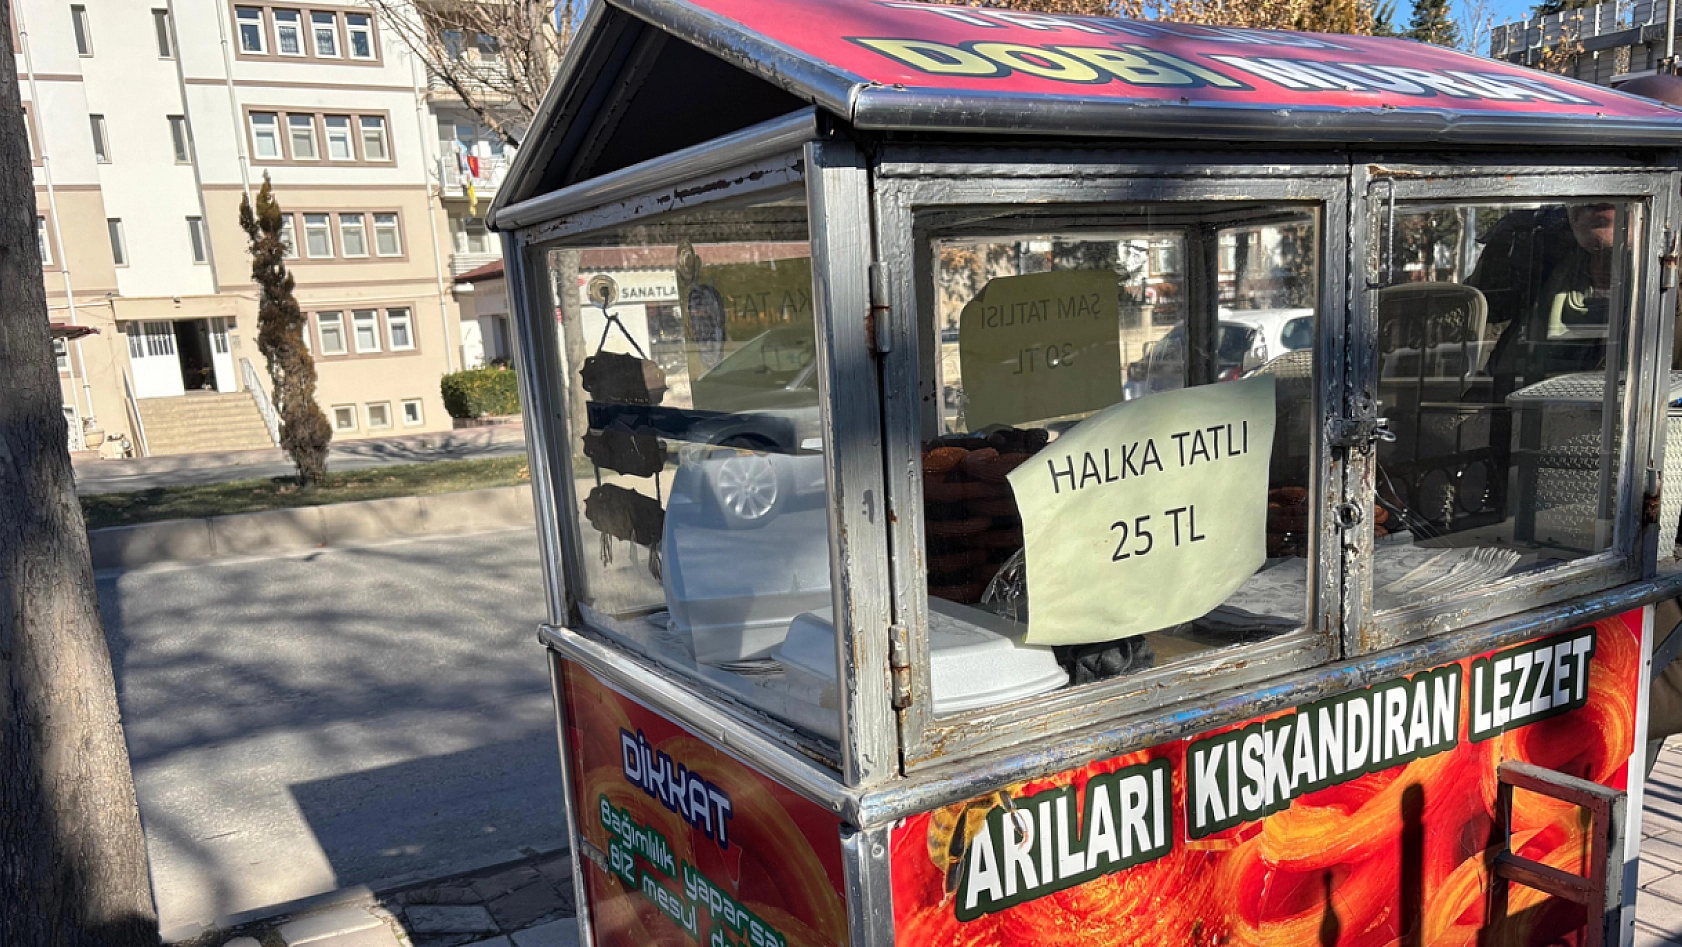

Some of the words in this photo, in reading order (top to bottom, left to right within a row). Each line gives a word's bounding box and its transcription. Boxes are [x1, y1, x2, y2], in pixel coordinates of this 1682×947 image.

[856, 37, 1244, 88] DOBİ
[1210, 54, 1591, 104] MURAT
[1047, 438, 1164, 494] HALKA
[1170, 420, 1248, 468] TATLI
[1110, 514, 1153, 563] 25
[1164, 504, 1206, 547] TL
[621, 730, 731, 842] DİKKAT
[965, 768, 1165, 910] ARILARI
[1194, 673, 1457, 828] KISKANDIRAN
[1474, 634, 1592, 734] LEZZET
[601, 799, 676, 876] Bağımlılık
[642, 876, 697, 935] mesul
